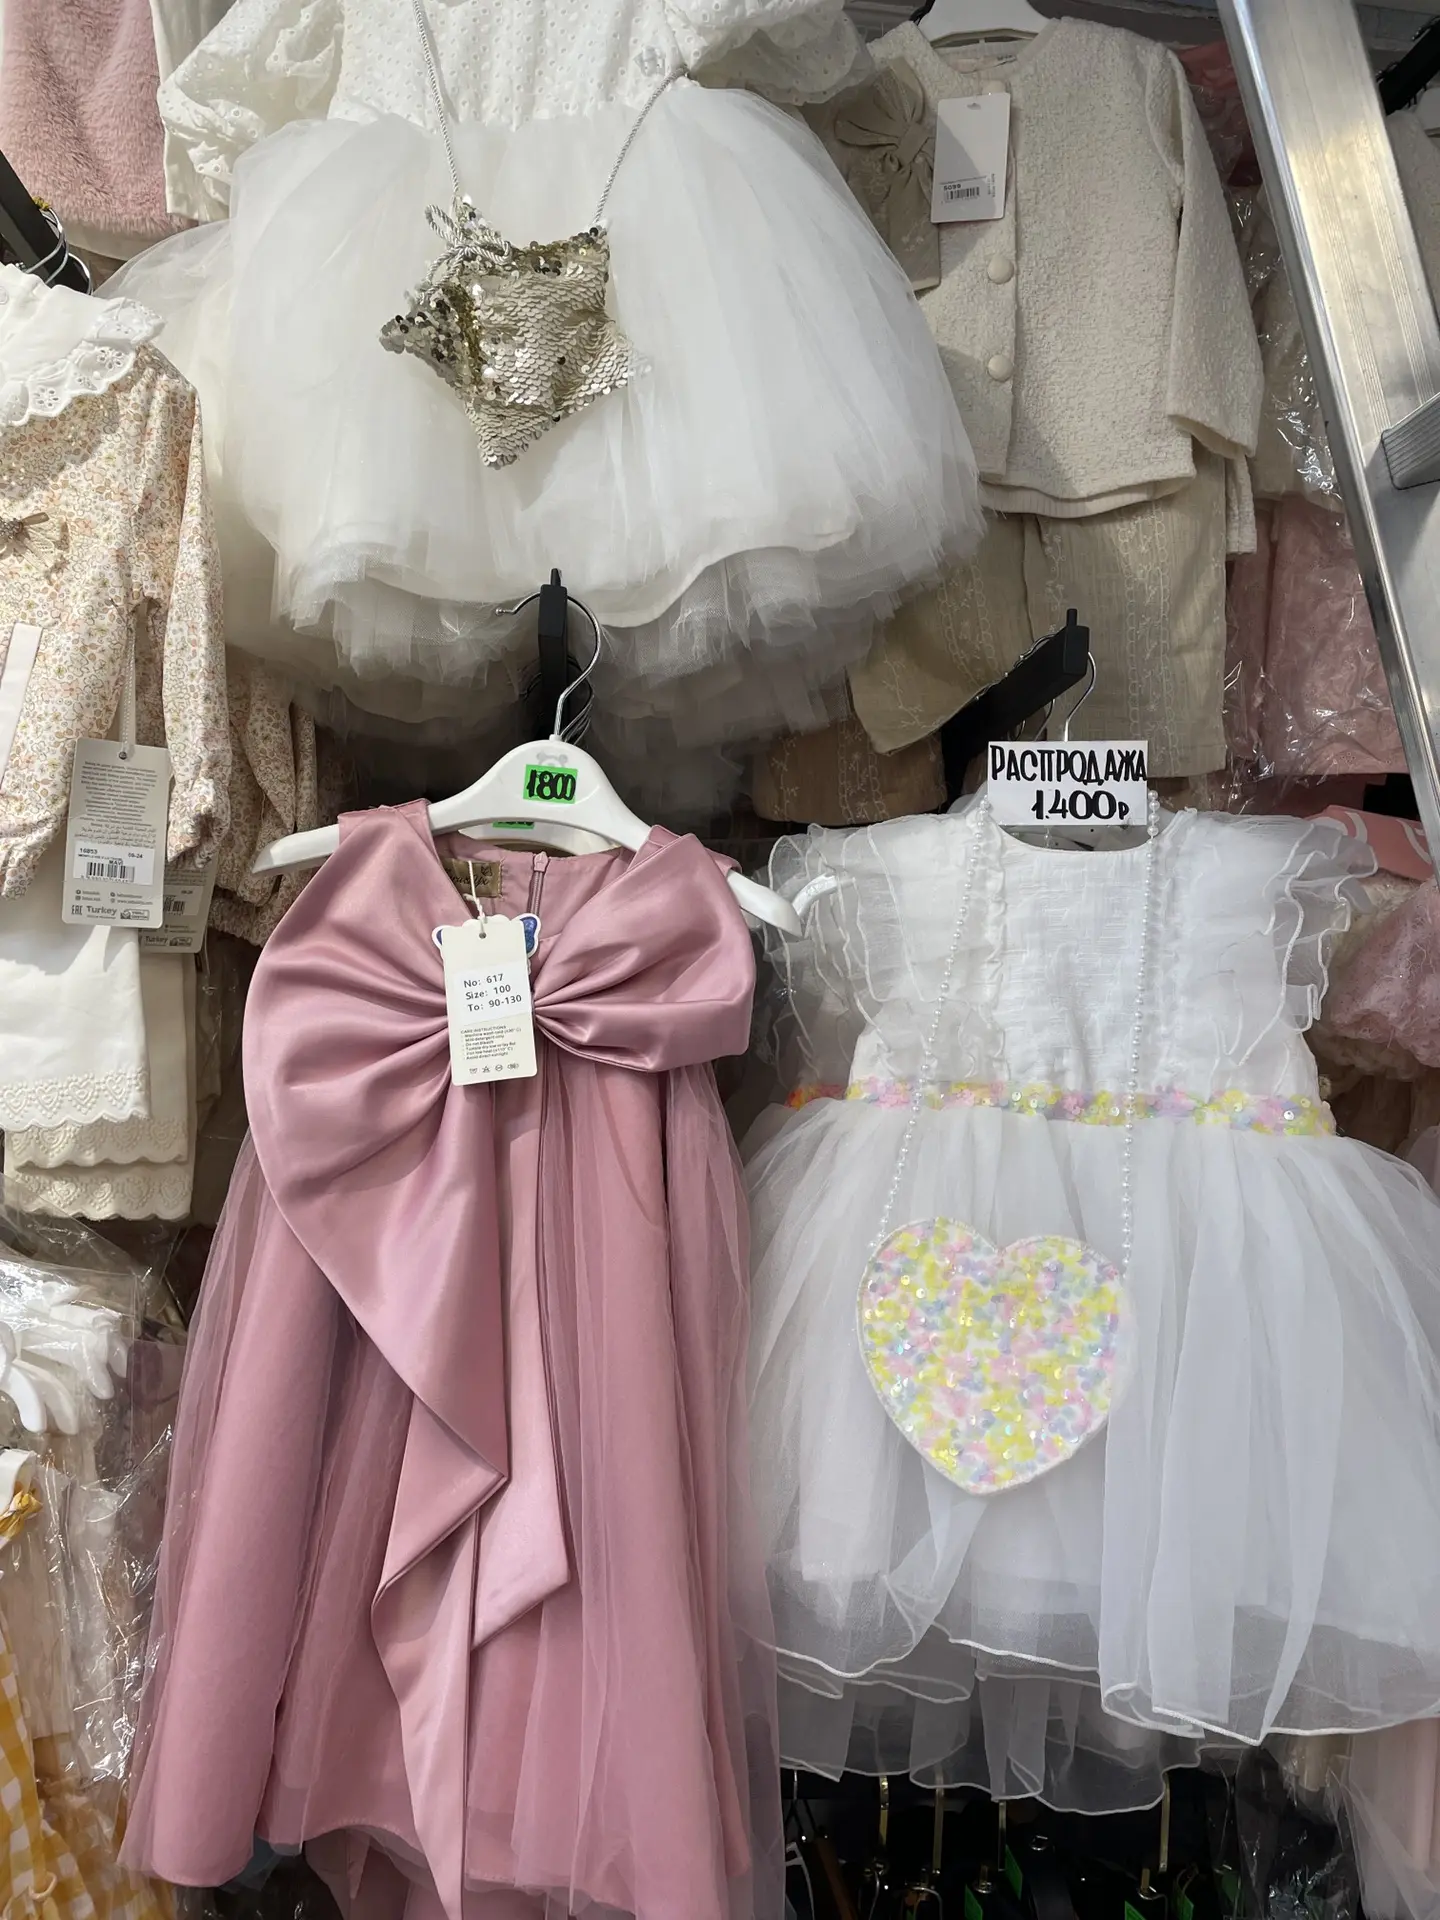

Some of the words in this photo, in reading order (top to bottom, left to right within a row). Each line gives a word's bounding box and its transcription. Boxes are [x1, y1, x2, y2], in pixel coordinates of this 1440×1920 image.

[990, 745, 1148, 786] РАСПРОДАЖА
[526, 769, 576, 801] 1800
[86, 905, 117, 916] Turkey
[463, 979, 481, 988] No:
[486, 973, 504, 984] 617
[465, 990, 488, 1000] Size:
[493, 984, 511, 995] 100
[467, 1003, 484, 1012] To:
[488, 994, 522, 1008] 90-130
